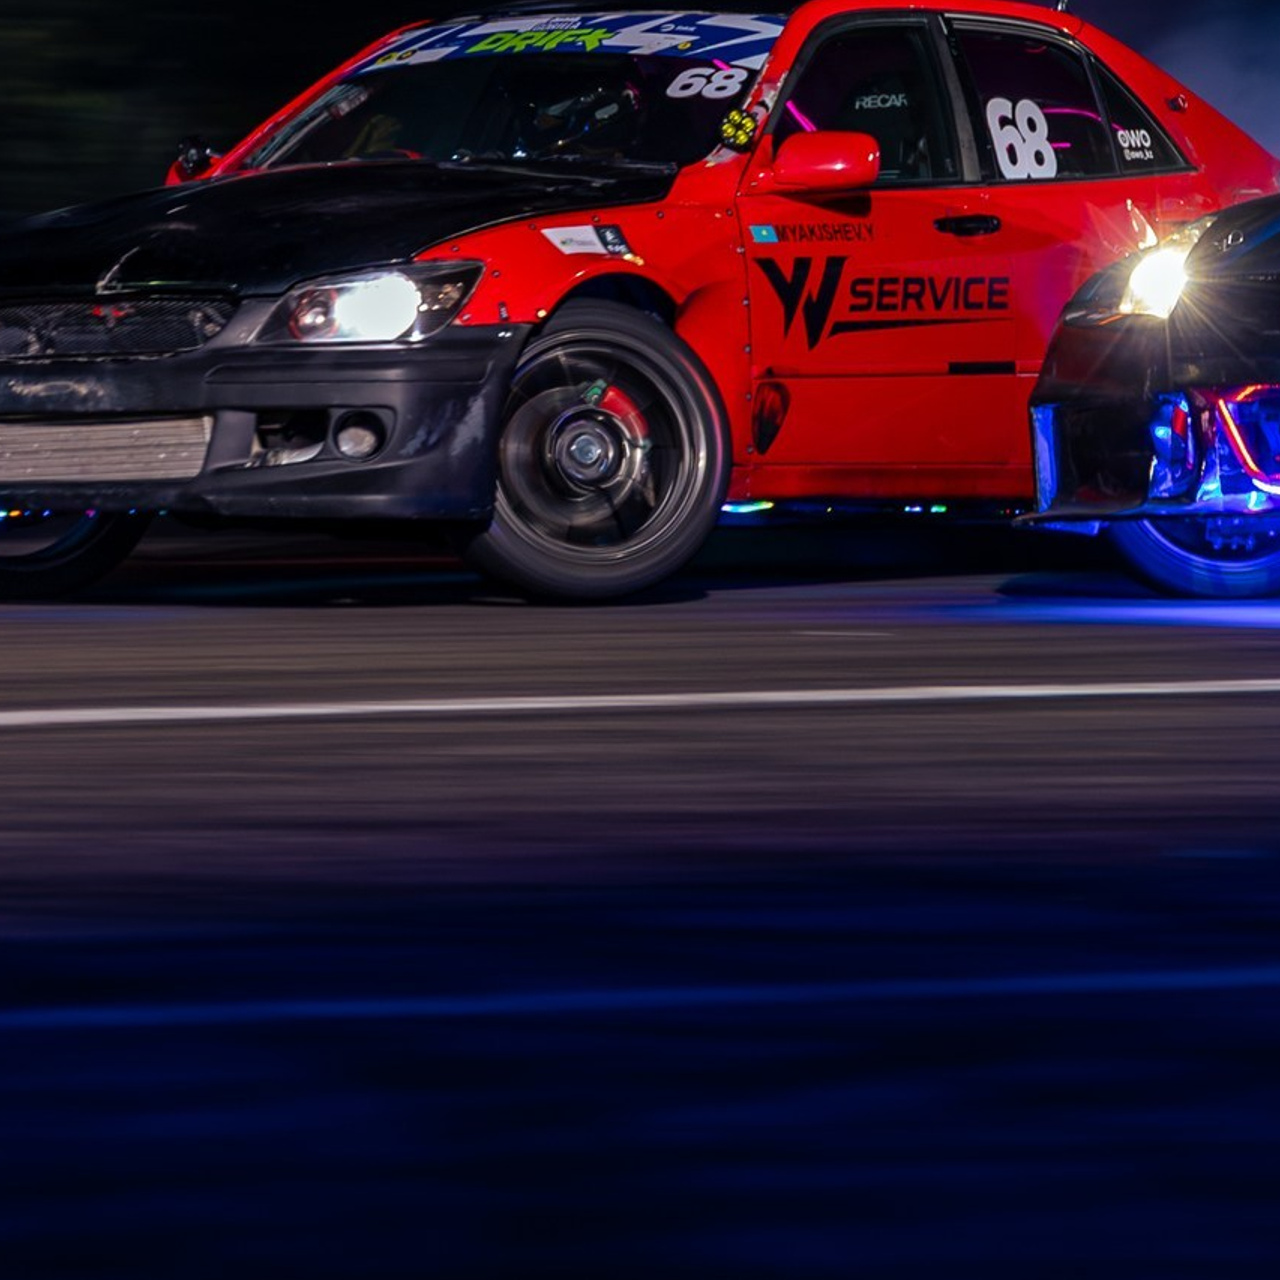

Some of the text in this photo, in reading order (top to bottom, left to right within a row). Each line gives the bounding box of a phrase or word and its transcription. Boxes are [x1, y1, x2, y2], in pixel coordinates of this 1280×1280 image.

[666, 67, 749, 99] 68
[986, 97, 1057, 180] 68
[849, 277, 1010, 312] SERVICE
